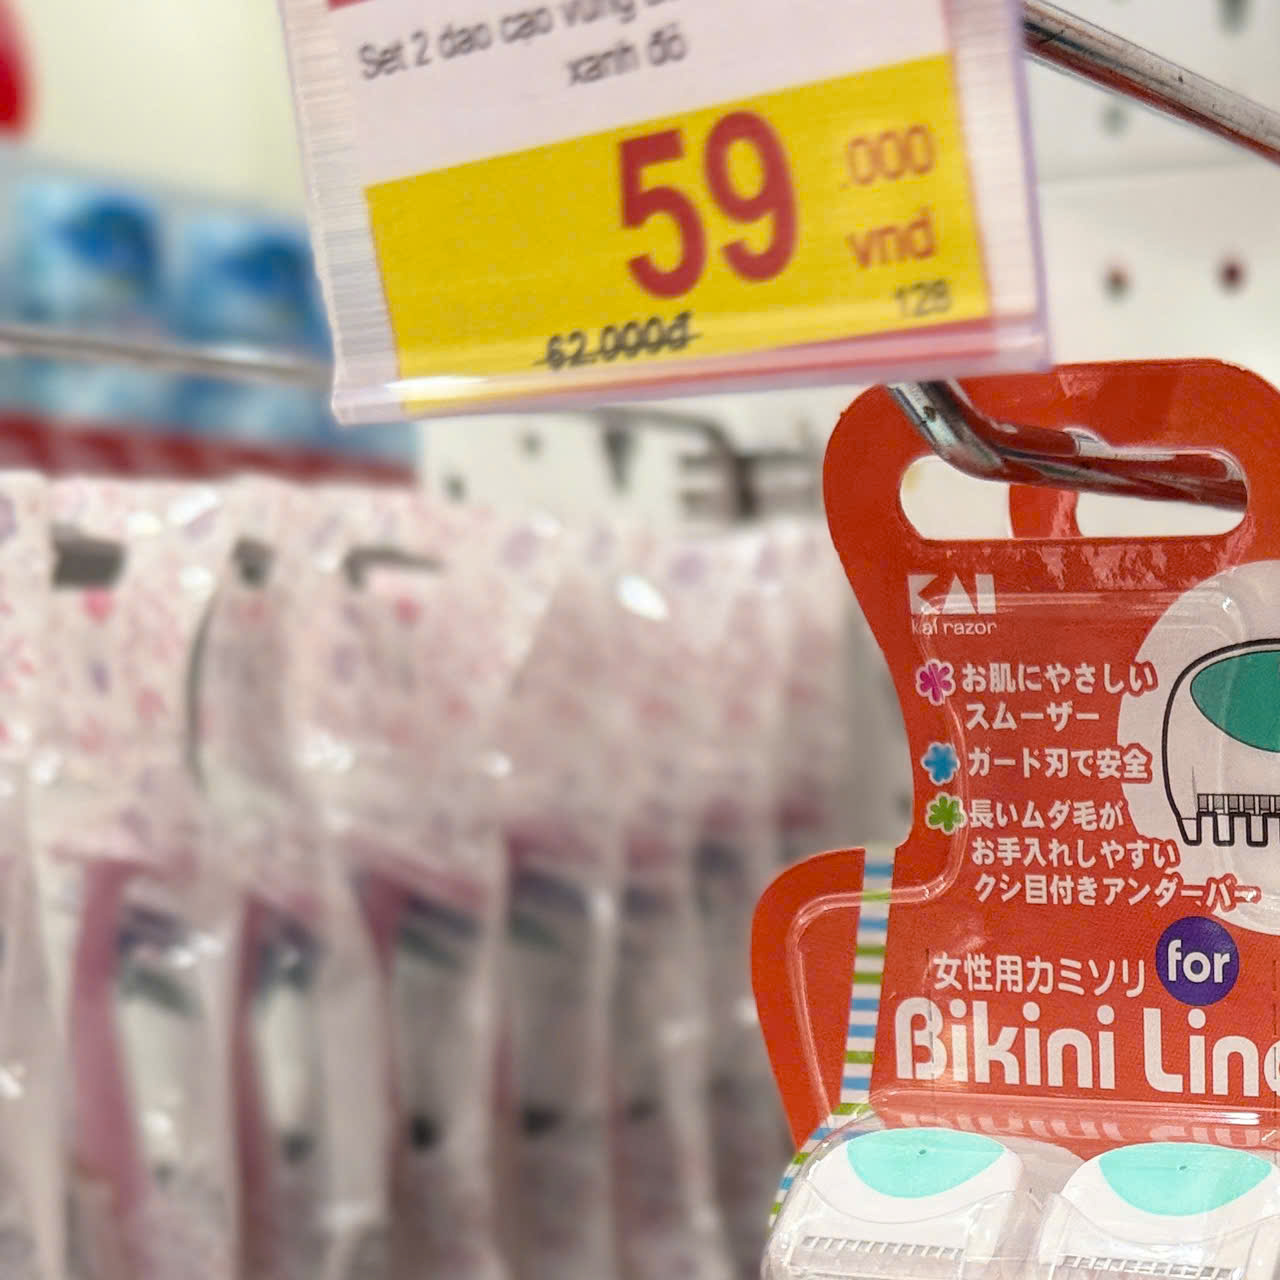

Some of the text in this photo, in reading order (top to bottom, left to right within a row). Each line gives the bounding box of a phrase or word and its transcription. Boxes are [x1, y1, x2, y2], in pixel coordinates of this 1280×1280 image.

[358, 42, 406, 80] Set
[410, 30, 430, 66] 2
[437, 24, 493, 59] dao
[618, 110, 798, 299] 59
[846, 210, 938, 272] vnd
[907, 573, 997, 615] KAI
[911, 619, 998, 636] kai razor
[961, 662, 1156, 695] お肌にやさしい
[965, 701, 1099, 732] スムーザー
[967, 746, 1149, 780] ガード刃で安全
[969, 799, 1125, 830] 長いムダ毛が
[971, 837, 1177, 868] お手入れしやすい
[975, 874, 1260, 908] クシ目付きアンダーバー
[932, 938, 1231, 999] 女性用カミソリ for
[893, 996, 1116, 1091] Bikini
